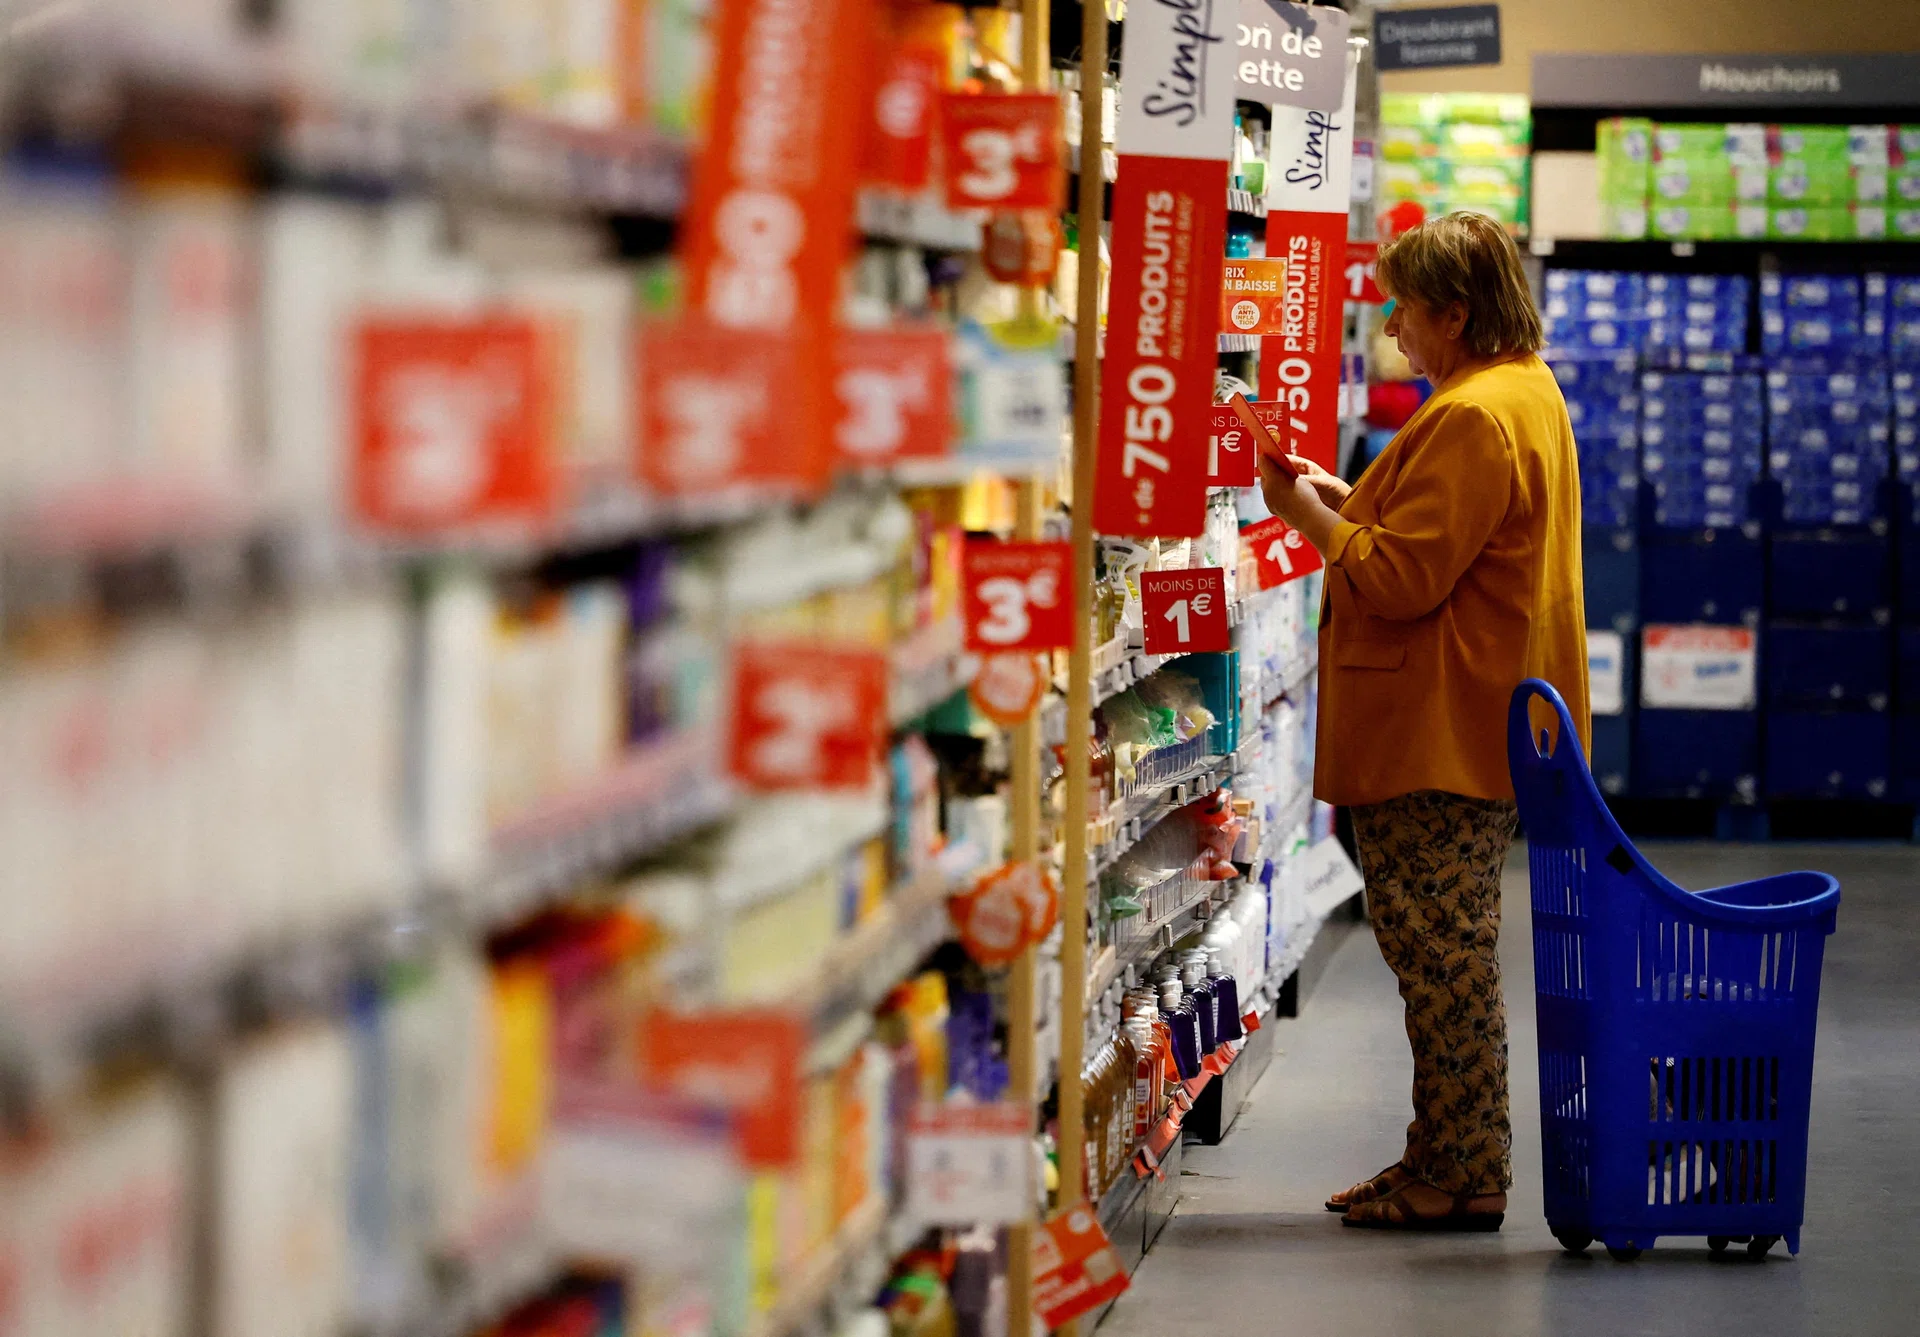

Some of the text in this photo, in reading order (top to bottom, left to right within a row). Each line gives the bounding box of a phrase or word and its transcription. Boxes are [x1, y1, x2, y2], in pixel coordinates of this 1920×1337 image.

[1281, 26, 1323, 59] de
[1238, 58, 1304, 91] ette
[1699, 62, 1842, 93] Mouchoirs
[1136, 190, 1175, 358] PRODUITS
[1225, 267, 1246, 279] RIX
[1235, 280, 1277, 292] BAISSE
[1309, 263, 1321, 293] PLUS
[1284, 235, 1308, 352] PRODUITS
[1309, 294, 1320, 309] LE
[1307, 311, 1318, 336] PRIX
[1306, 338, 1317, 353] AU
[1122, 364, 1177, 479] 750
[1266, 410, 1283, 422] DE
[1265, 528, 1304, 576] 1€
[1148, 577, 1217, 593] MOINS DE
[976, 567, 1060, 645] 3€
[1163, 593, 1212, 643] 1€
